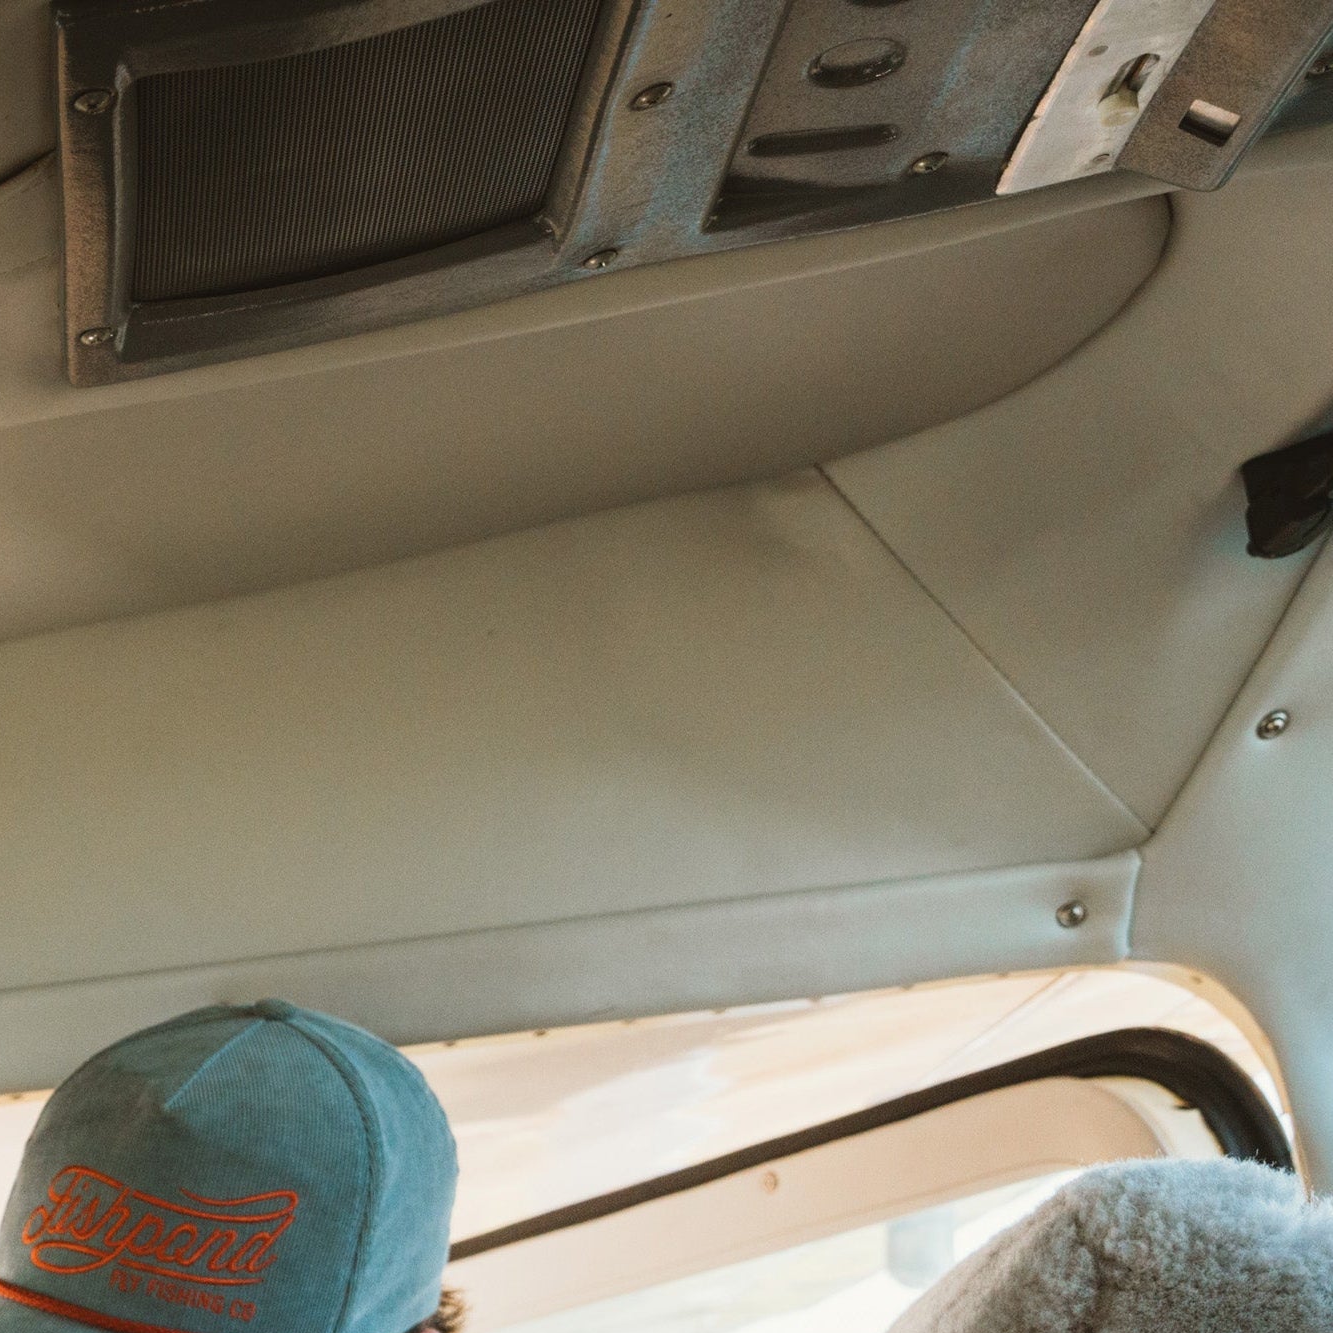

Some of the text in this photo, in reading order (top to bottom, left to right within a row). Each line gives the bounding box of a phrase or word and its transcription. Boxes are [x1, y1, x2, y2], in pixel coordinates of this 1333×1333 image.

[22, 1165, 298, 1274] Fishpond
[109, 1268, 257, 1323] FLY FISHING CO
